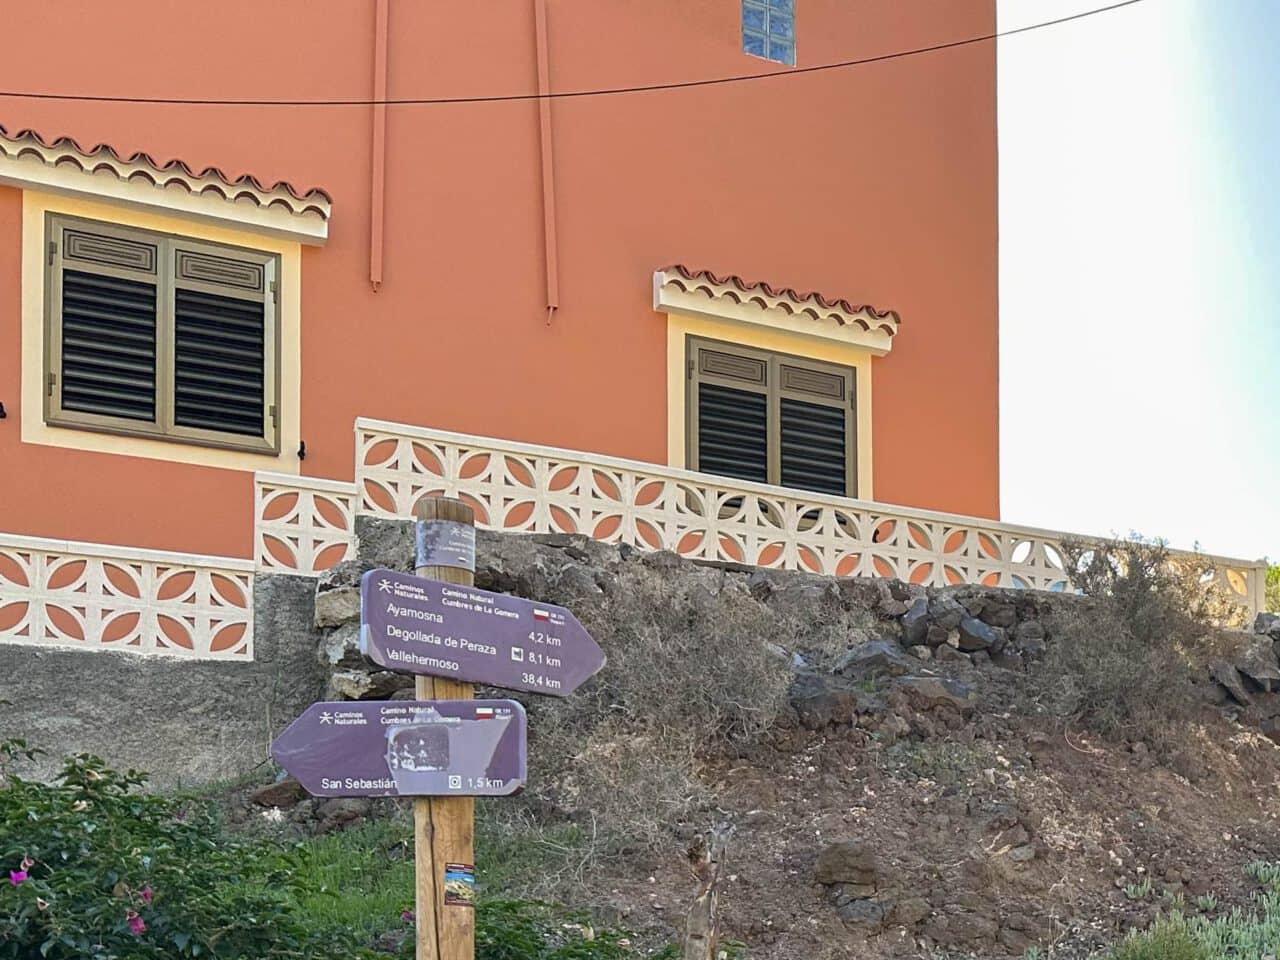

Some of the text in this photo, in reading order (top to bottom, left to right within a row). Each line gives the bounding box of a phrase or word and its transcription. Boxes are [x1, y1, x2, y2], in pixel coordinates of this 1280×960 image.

[394, 582, 424, 594] Caminos
[394, 590, 429, 601] Naturales
[441, 587, 494, 605] Camino Natural
[387, 603, 443, 623] Ayamosna
[442, 598, 473, 610] Cumbres
[474, 604, 483, 612] de
[494, 607, 520, 619] Gomera
[386, 625, 497, 655] Degollada de Peraza
[528, 632, 562, 647] 4,2 km
[386, 647, 459, 671] Vallehermoso
[528, 653, 562, 668] 8,1 km
[521, 672, 562, 689] 38,4 km
[334, 711, 363, 719] Caminos
[380, 705, 435, 715] Camino Natural
[334, 718, 367, 726] Naturales
[321, 777, 398, 790] San Sebastián
[467, 777, 504, 790] 1,5 km
